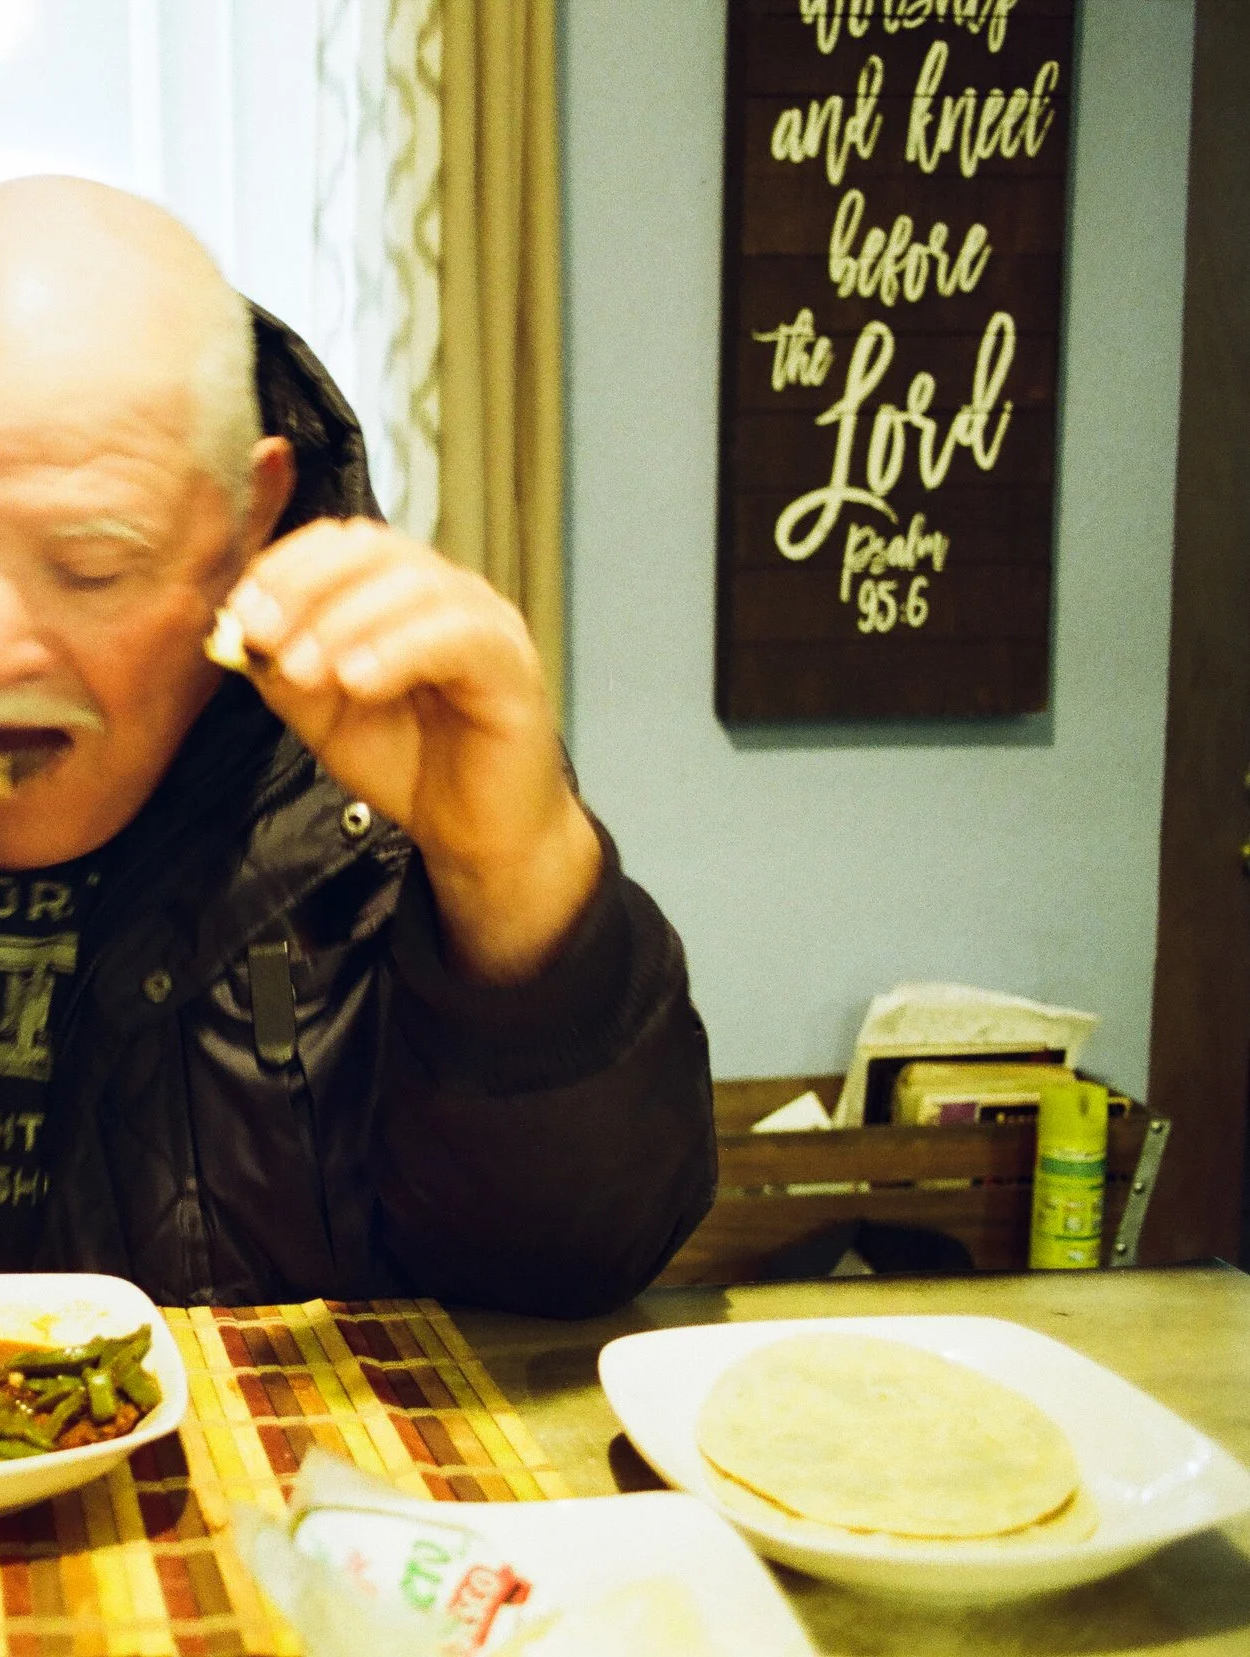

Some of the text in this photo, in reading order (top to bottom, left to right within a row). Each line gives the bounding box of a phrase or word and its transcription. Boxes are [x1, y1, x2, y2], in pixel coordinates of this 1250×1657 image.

[770, 39, 1060, 187] and kneel
[828, 188, 993, 307] before
[752, 307, 1016, 561] the Lord
